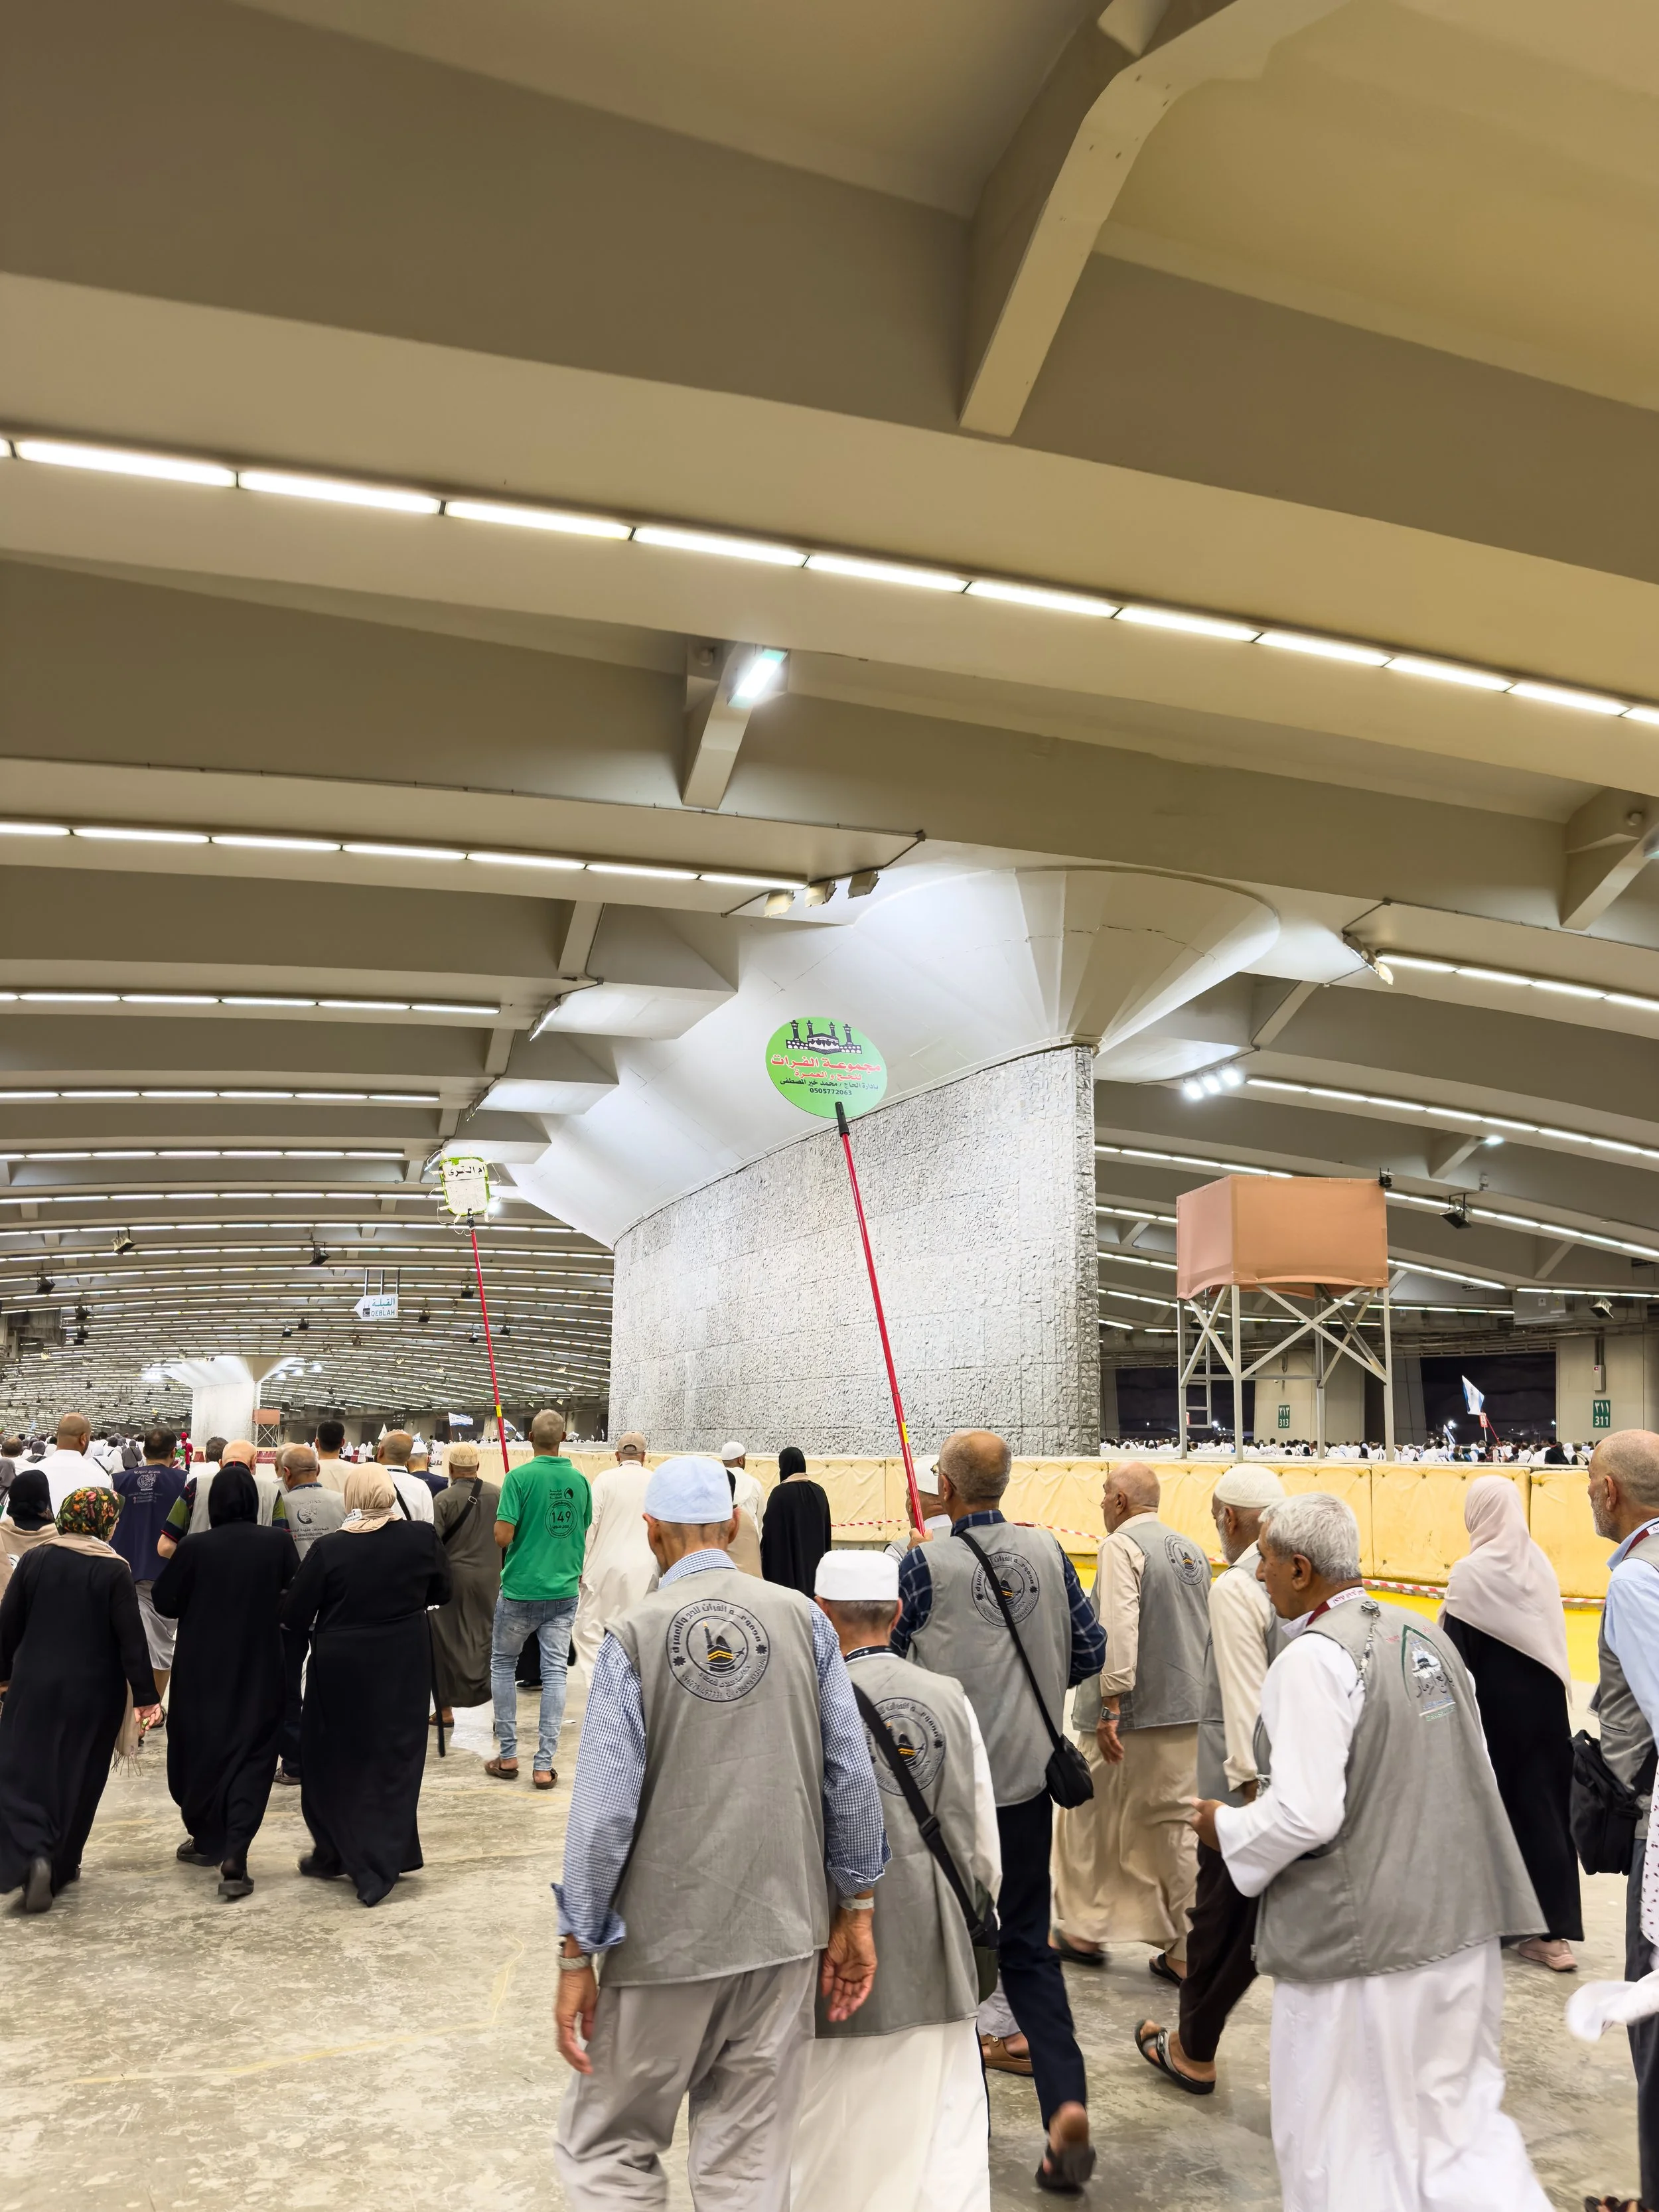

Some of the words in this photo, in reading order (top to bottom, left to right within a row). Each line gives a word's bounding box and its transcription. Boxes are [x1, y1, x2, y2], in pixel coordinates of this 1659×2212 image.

[771, 1055, 819, 1068] الفرات
[822, 1057, 881, 1073] مجموعة
[795, 1069, 827, 1078] العمرة
[372, 1297, 395, 1309] القبلة
[1279, 1418, 1289, 1427] 313
[1595, 1416, 1609, 1426] 311
[551, 1511, 571, 1523] 149
[685, 1606, 701, 1620] للحج
[729, 1607, 762, 1642] مجموعة
